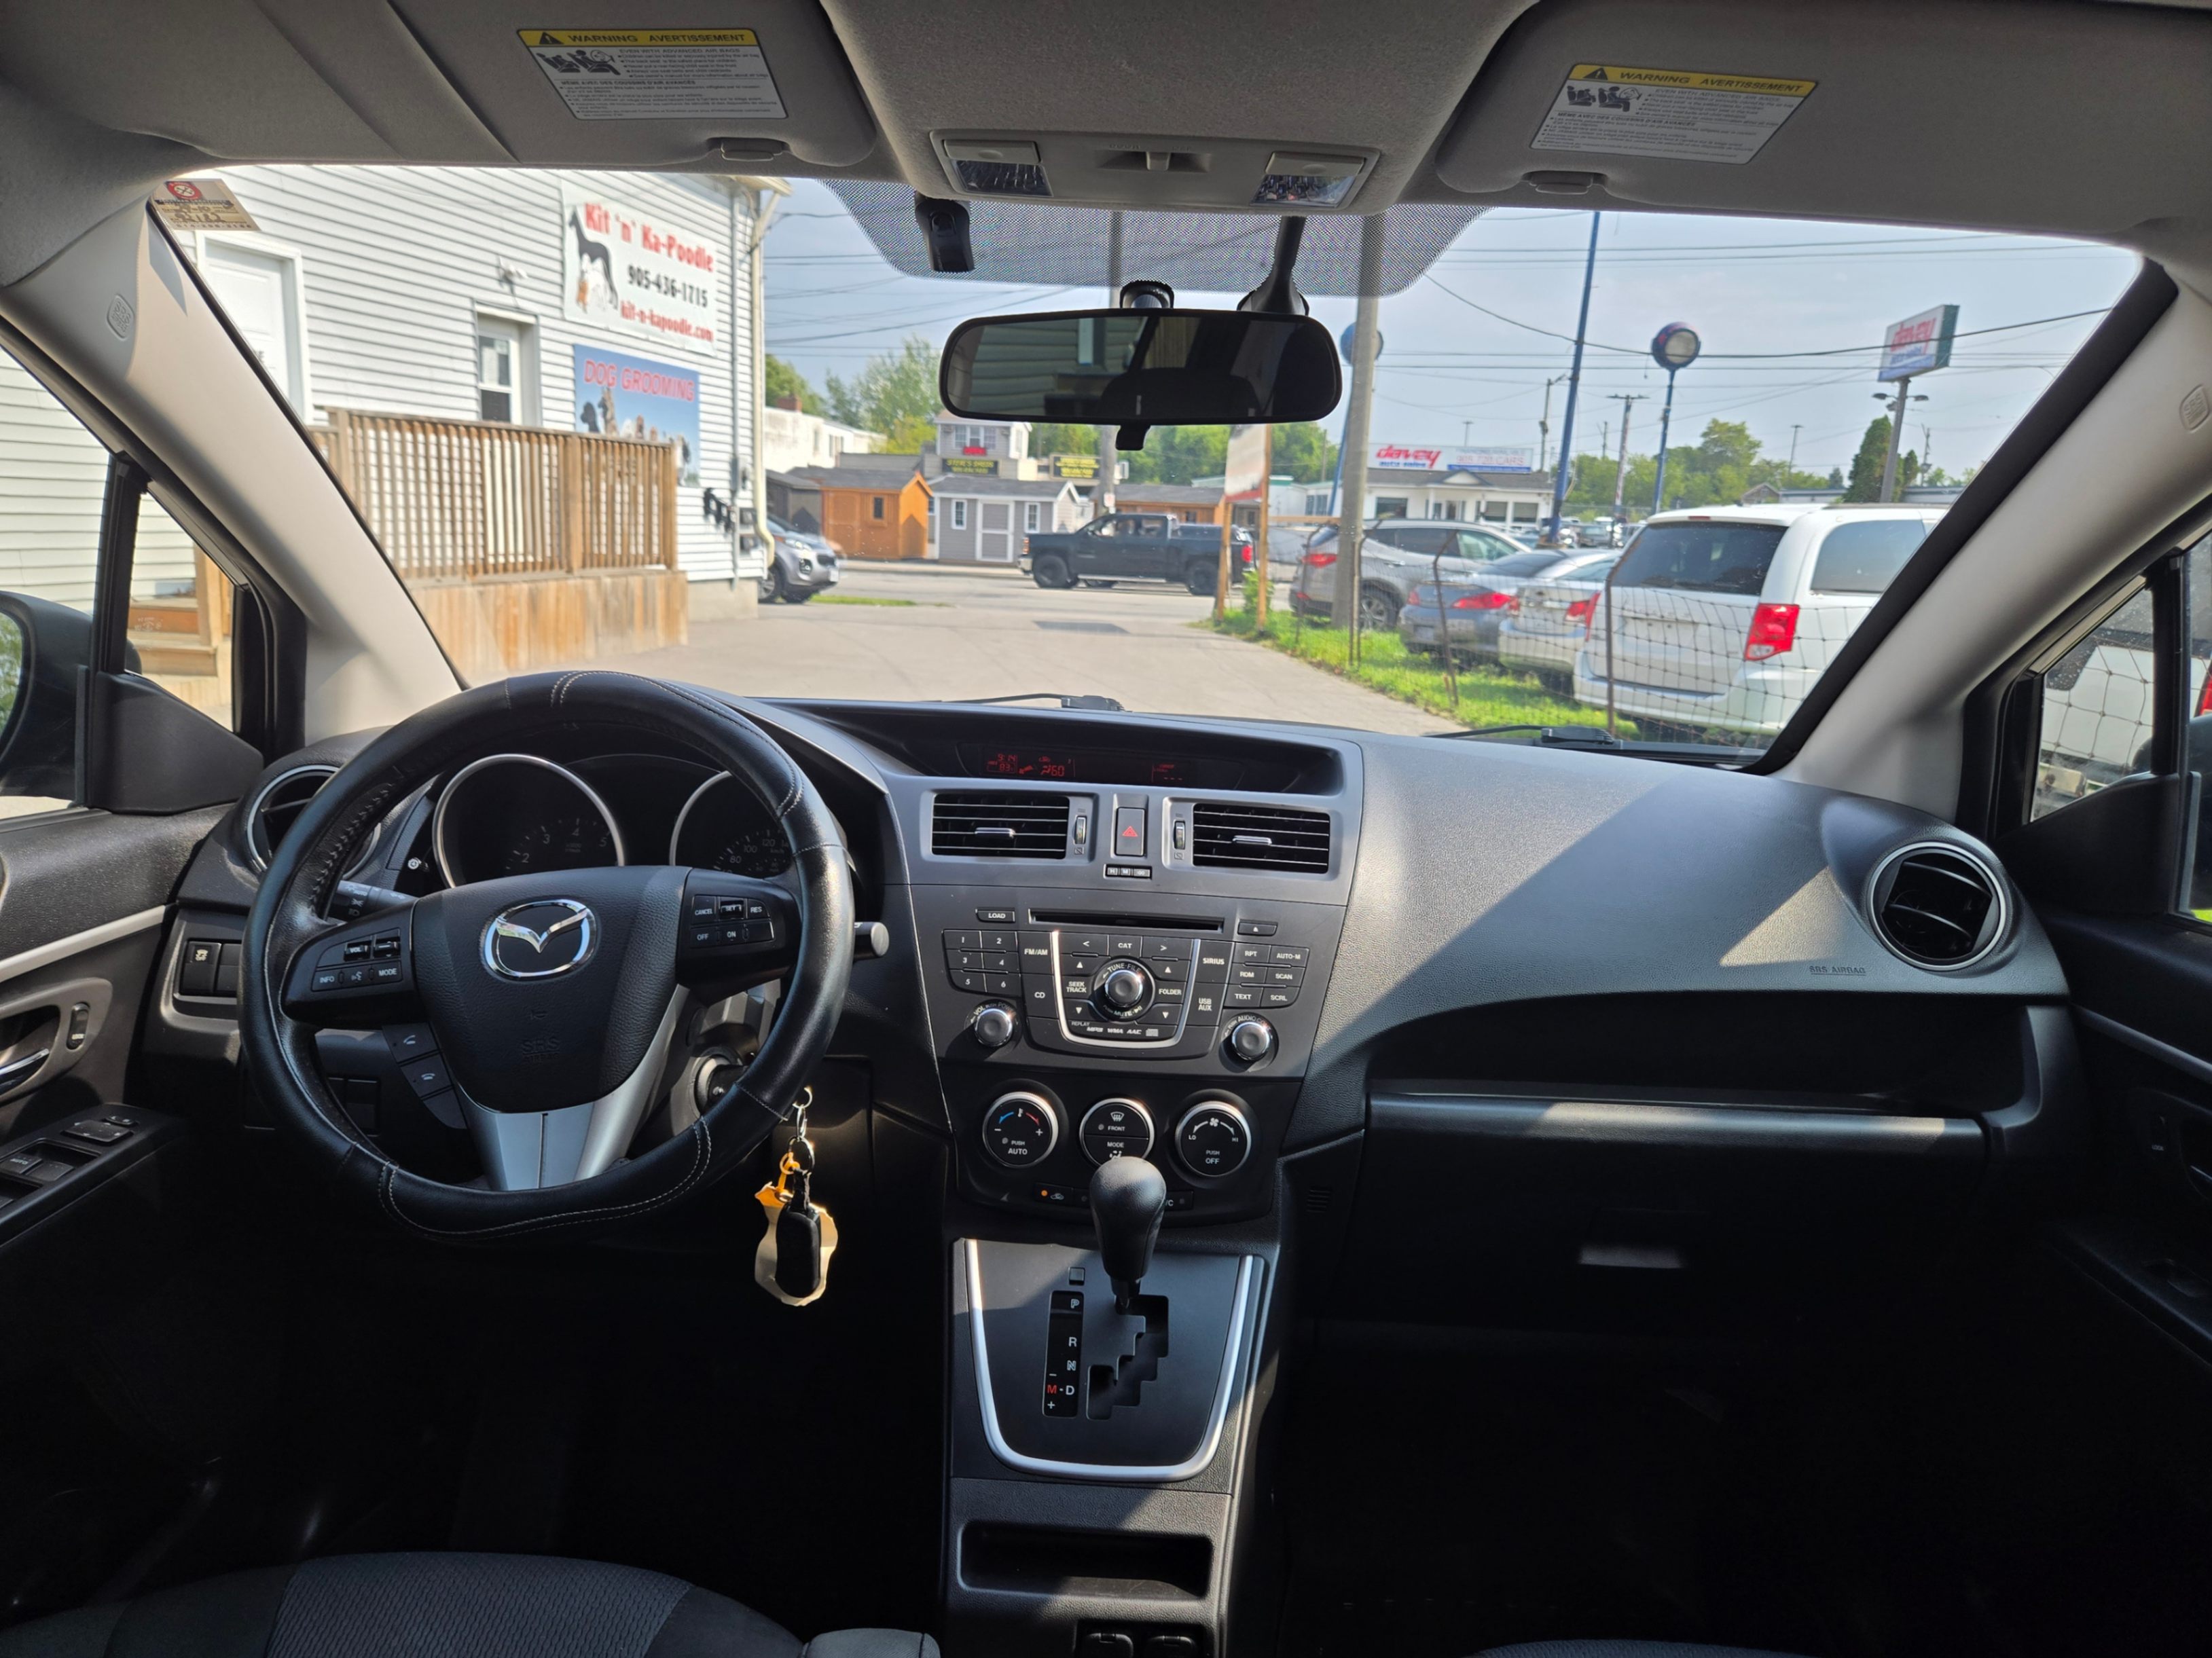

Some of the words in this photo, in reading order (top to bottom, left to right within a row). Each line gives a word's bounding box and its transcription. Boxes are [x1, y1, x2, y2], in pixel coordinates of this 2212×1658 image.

[568, 35, 638, 43] WARNING
[649, 34, 745, 43] AVERTISSEMENT
[1620, 71, 1691, 85] WARNING
[1700, 77, 1804, 93] AVERTISSEMENT
[585, 202, 610, 234] Kit
[642, 225, 713, 272] Ka-Poodle
[628, 265, 708, 308] 905-436-1715
[620, 299, 713, 344] kit-n-kapoodle.com
[584, 358, 617, 388] DOG
[621, 368, 695, 402] GROOMING
[1376, 445, 1442, 469] davey
[543, 834, 550, 844] 3
[599, 837, 607, 847] 5
[744, 845, 758, 853] 100
[522, 853, 529, 863] 2
[729, 855, 742, 864] 80
[973, 1006, 985, 1016] VOL
[1070, 1299, 1080, 1308] P
[1068, 1337, 1077, 1347] R
[1067, 1360, 1076, 1371] N
[1047, 1385, 1057, 1394] M
[1066, 1386, 1074, 1395] D
